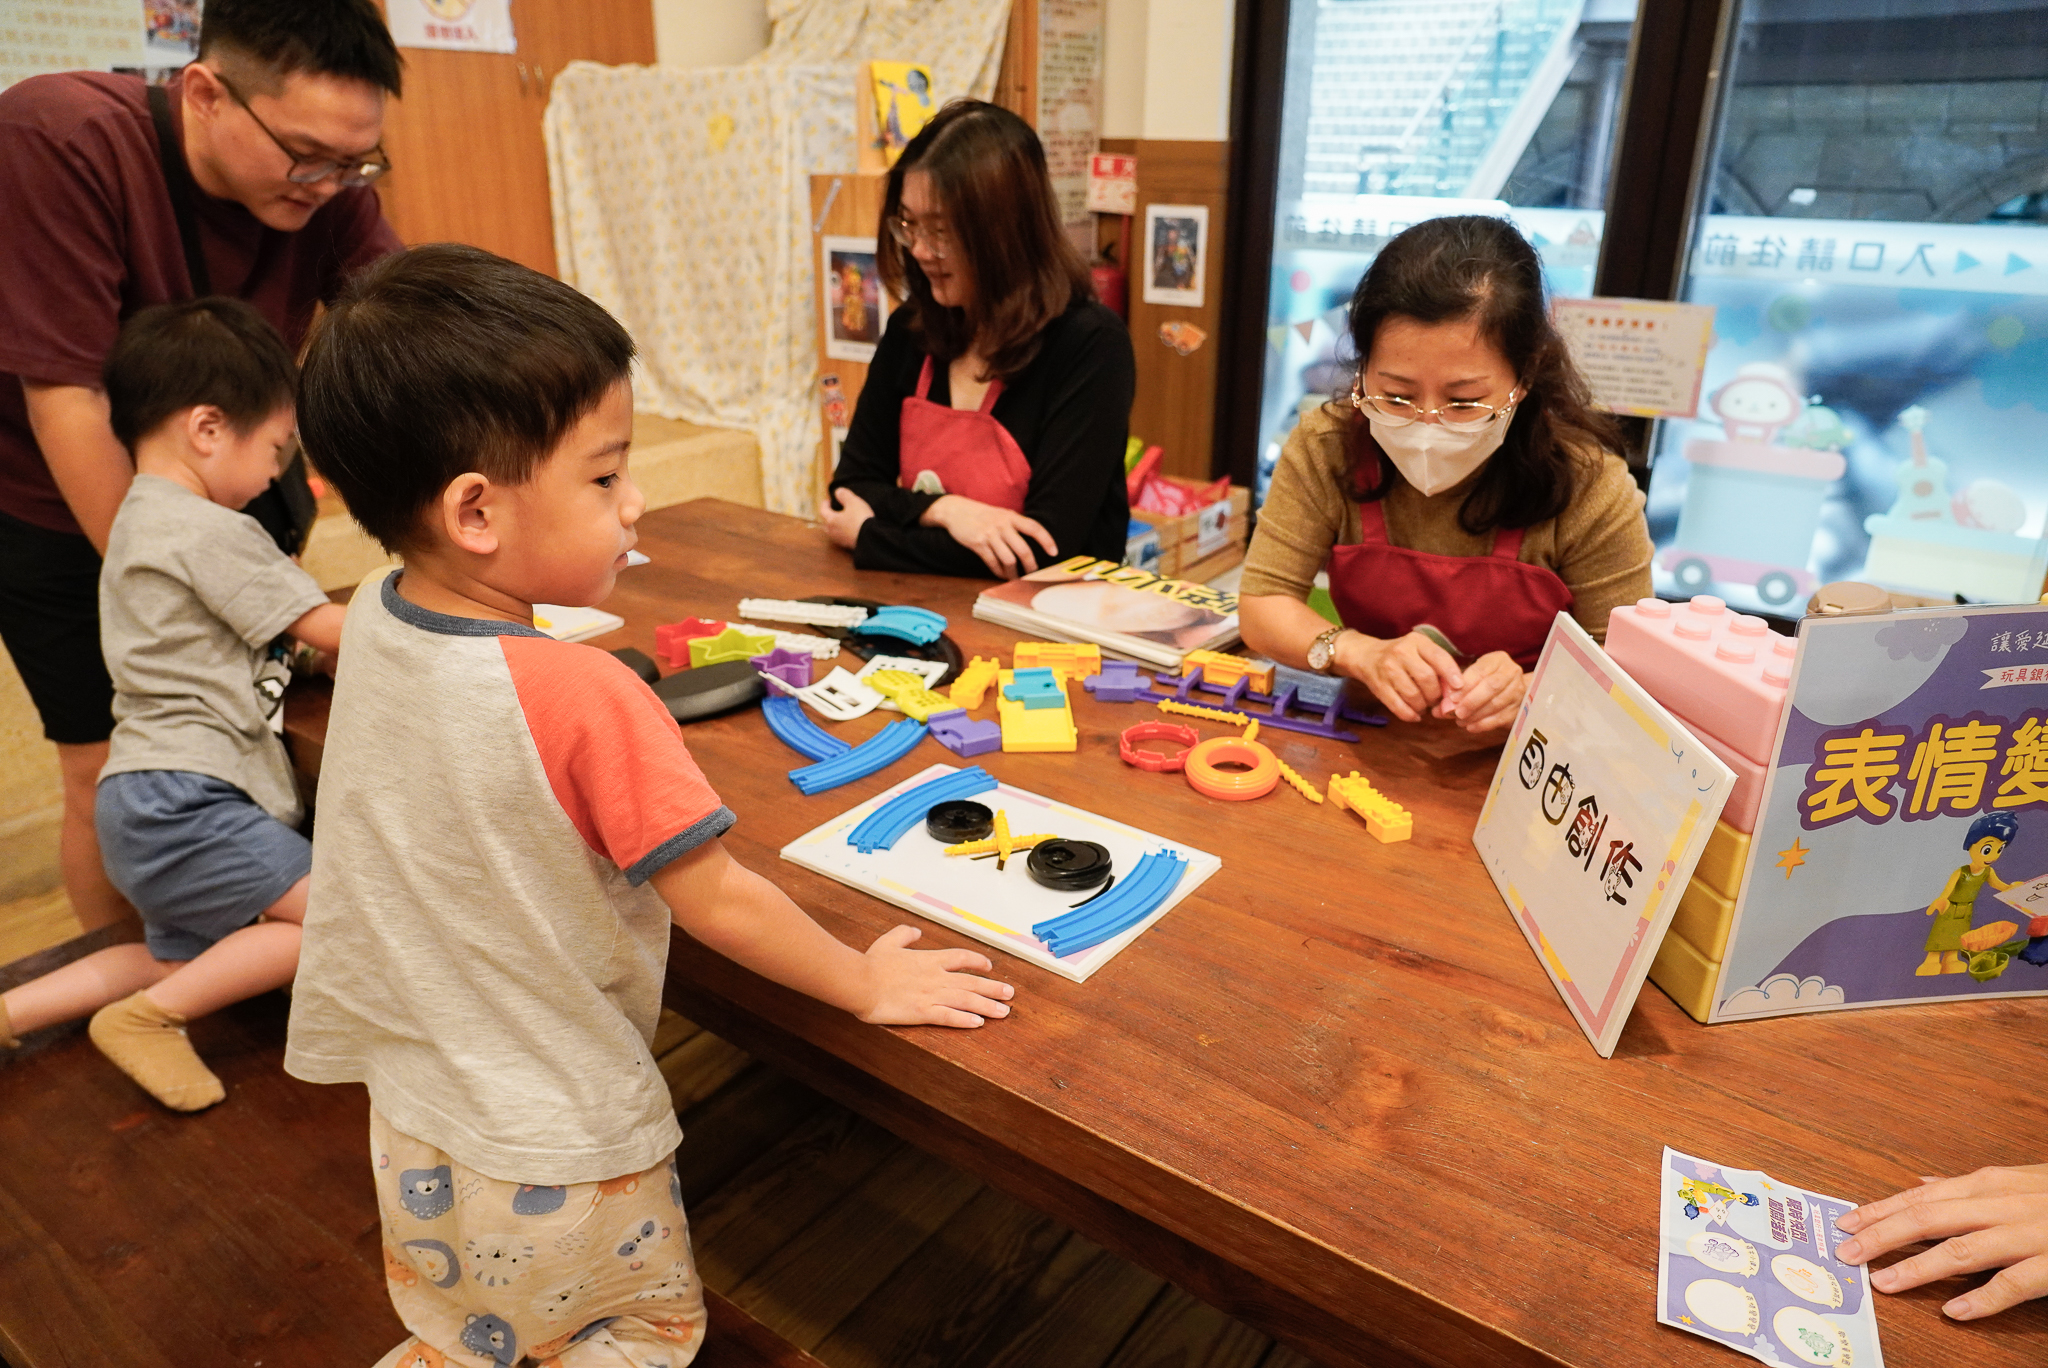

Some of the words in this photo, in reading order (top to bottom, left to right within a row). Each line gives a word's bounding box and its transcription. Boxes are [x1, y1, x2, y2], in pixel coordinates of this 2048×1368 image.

[2000, 667, 2048, 683] 玩具銀
[1519, 728, 1643, 906] 自由創作
[1767, 1196, 1789, 1244] 闖關活動
[1785, 1196, 1809, 1244] 限時快閃
